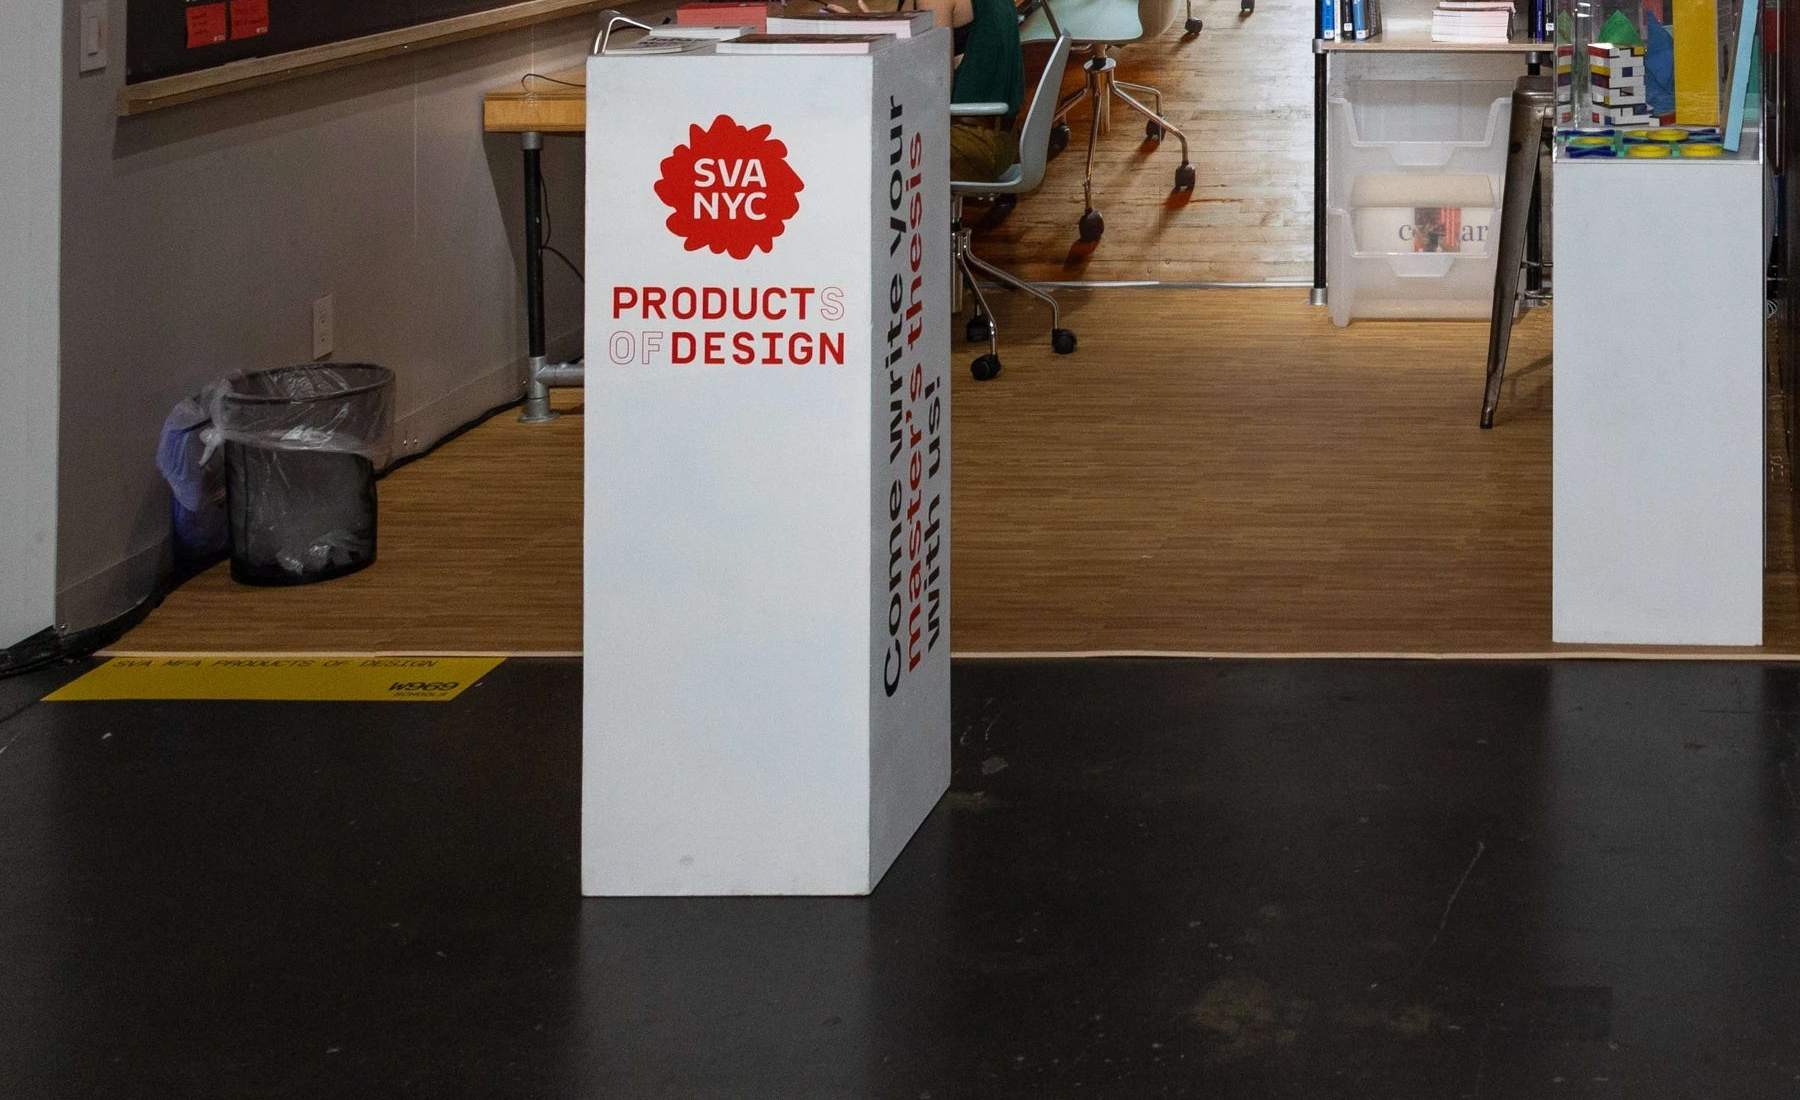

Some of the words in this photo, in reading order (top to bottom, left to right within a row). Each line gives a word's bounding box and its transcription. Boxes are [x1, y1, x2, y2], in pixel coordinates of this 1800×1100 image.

[693, 157, 767, 188] SVA
[693, 191, 767, 221] NYC
[889, 95, 907, 258] your
[905, 131, 923, 351] thesis
[609, 331, 664, 365] OF
[671, 331, 845, 365] DESIGN
[613, 286, 845, 321] PRODUCTS
[884, 273, 903, 465] write
[924, 375, 941, 479] us!
[905, 363, 923, 673] master's
[884, 479, 903, 698] Come
[924, 493, 940, 653] with
[112, 659, 152, 668] SVA
[160, 659, 201, 668] MFA
[210, 659, 315, 668] PRODUCTS
[323, 659, 349, 668] OF
[359, 659, 440, 668] DESIGN
[388, 681, 460, 692] W969
